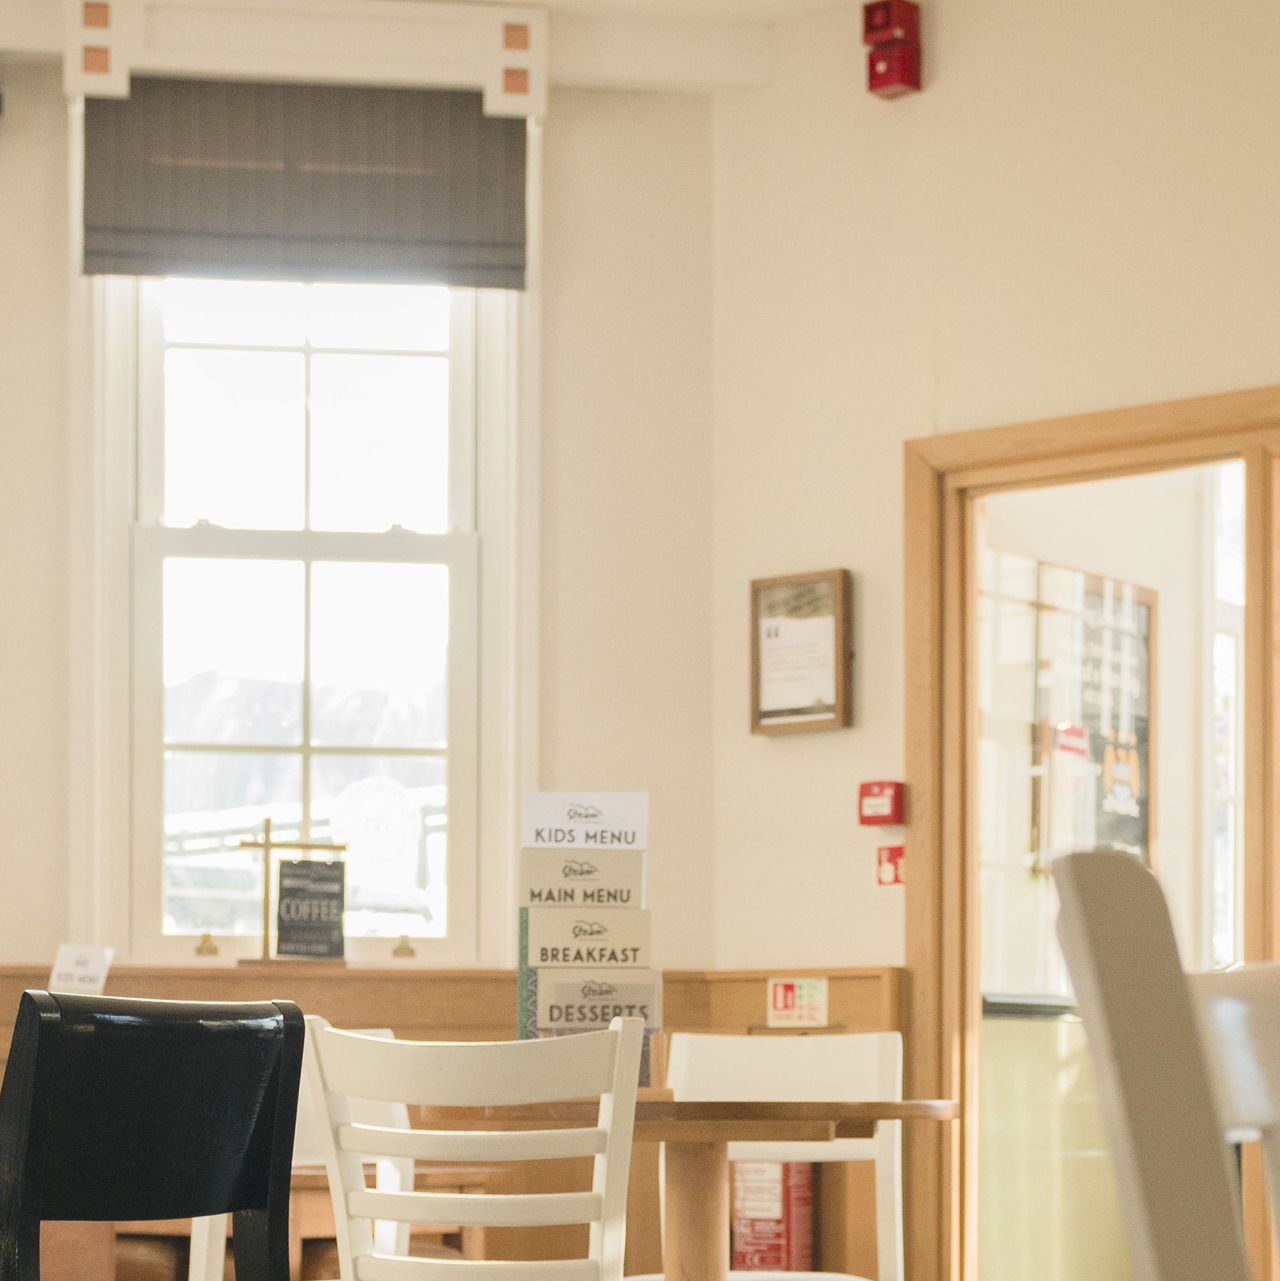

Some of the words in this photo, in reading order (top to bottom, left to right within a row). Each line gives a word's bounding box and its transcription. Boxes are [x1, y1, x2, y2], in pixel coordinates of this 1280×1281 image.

[534, 828, 576, 843] KIDS
[584, 831, 637, 845] MENU
[529, 889, 575, 903] MAIN
[582, 889, 632, 904] MENU
[280, 897, 339, 922] COFFEE
[540, 948, 640, 963] BREAKFAST
[549, 1004, 649, 1023] DESSERTS
